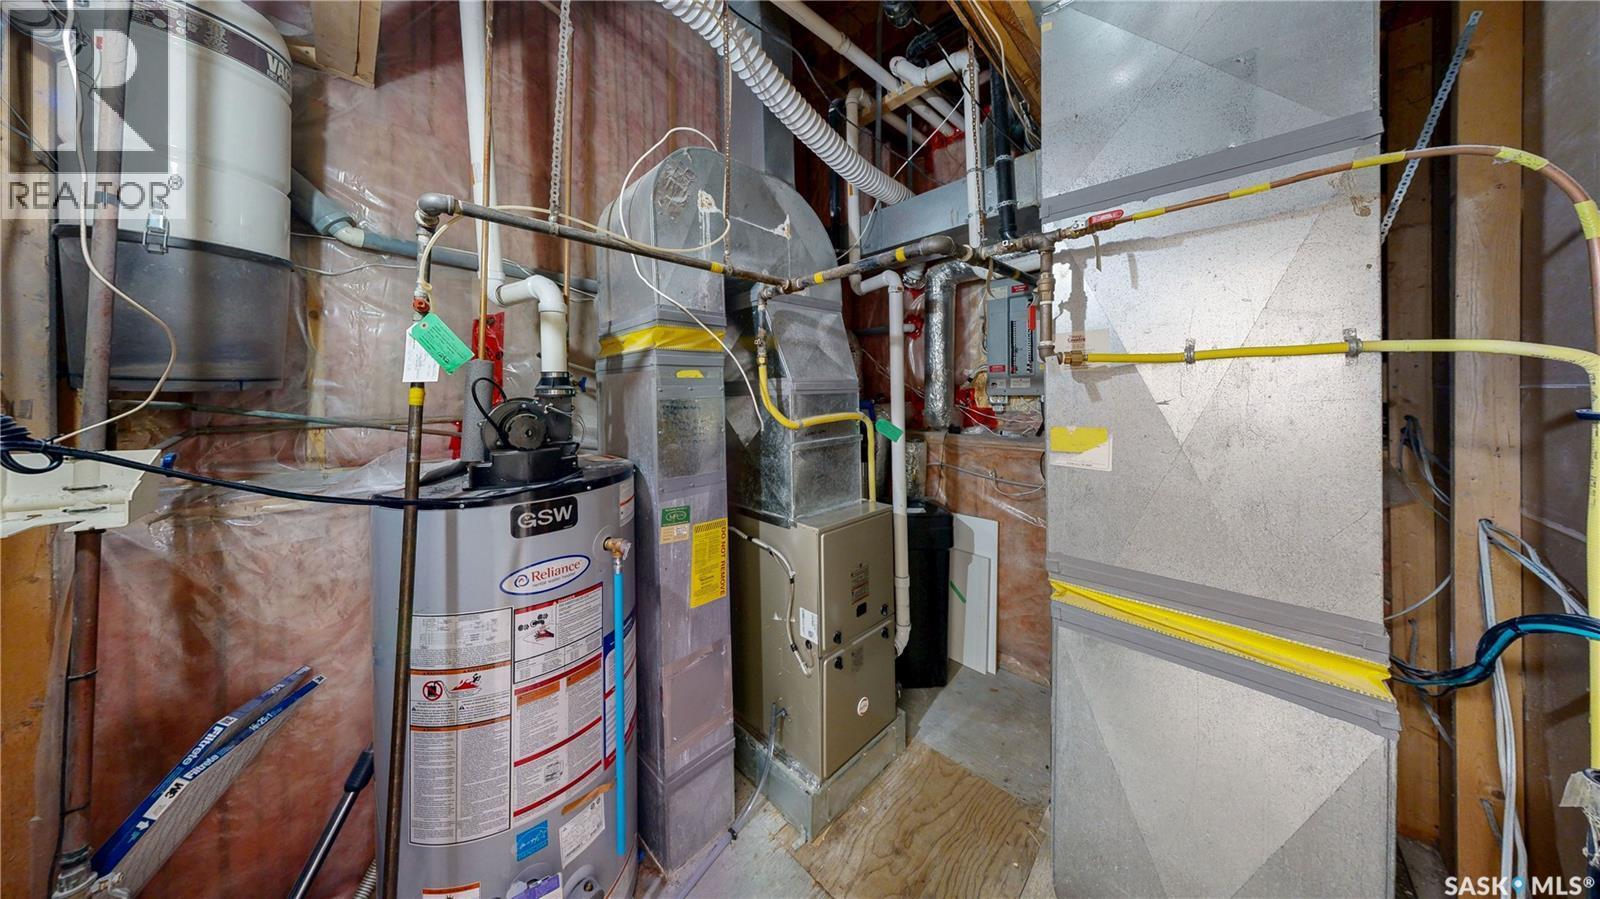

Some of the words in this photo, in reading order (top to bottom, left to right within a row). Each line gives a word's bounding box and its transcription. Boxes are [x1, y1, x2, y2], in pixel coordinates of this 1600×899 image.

[517, 505, 573, 528] GSW
[721, 527, 727, 539] DO
[531, 560, 581, 581] Reliance
[182, 726, 224, 766] Filtrete
[183, 754, 219, 779] Filtrete
[165, 782, 184, 799] 3M
